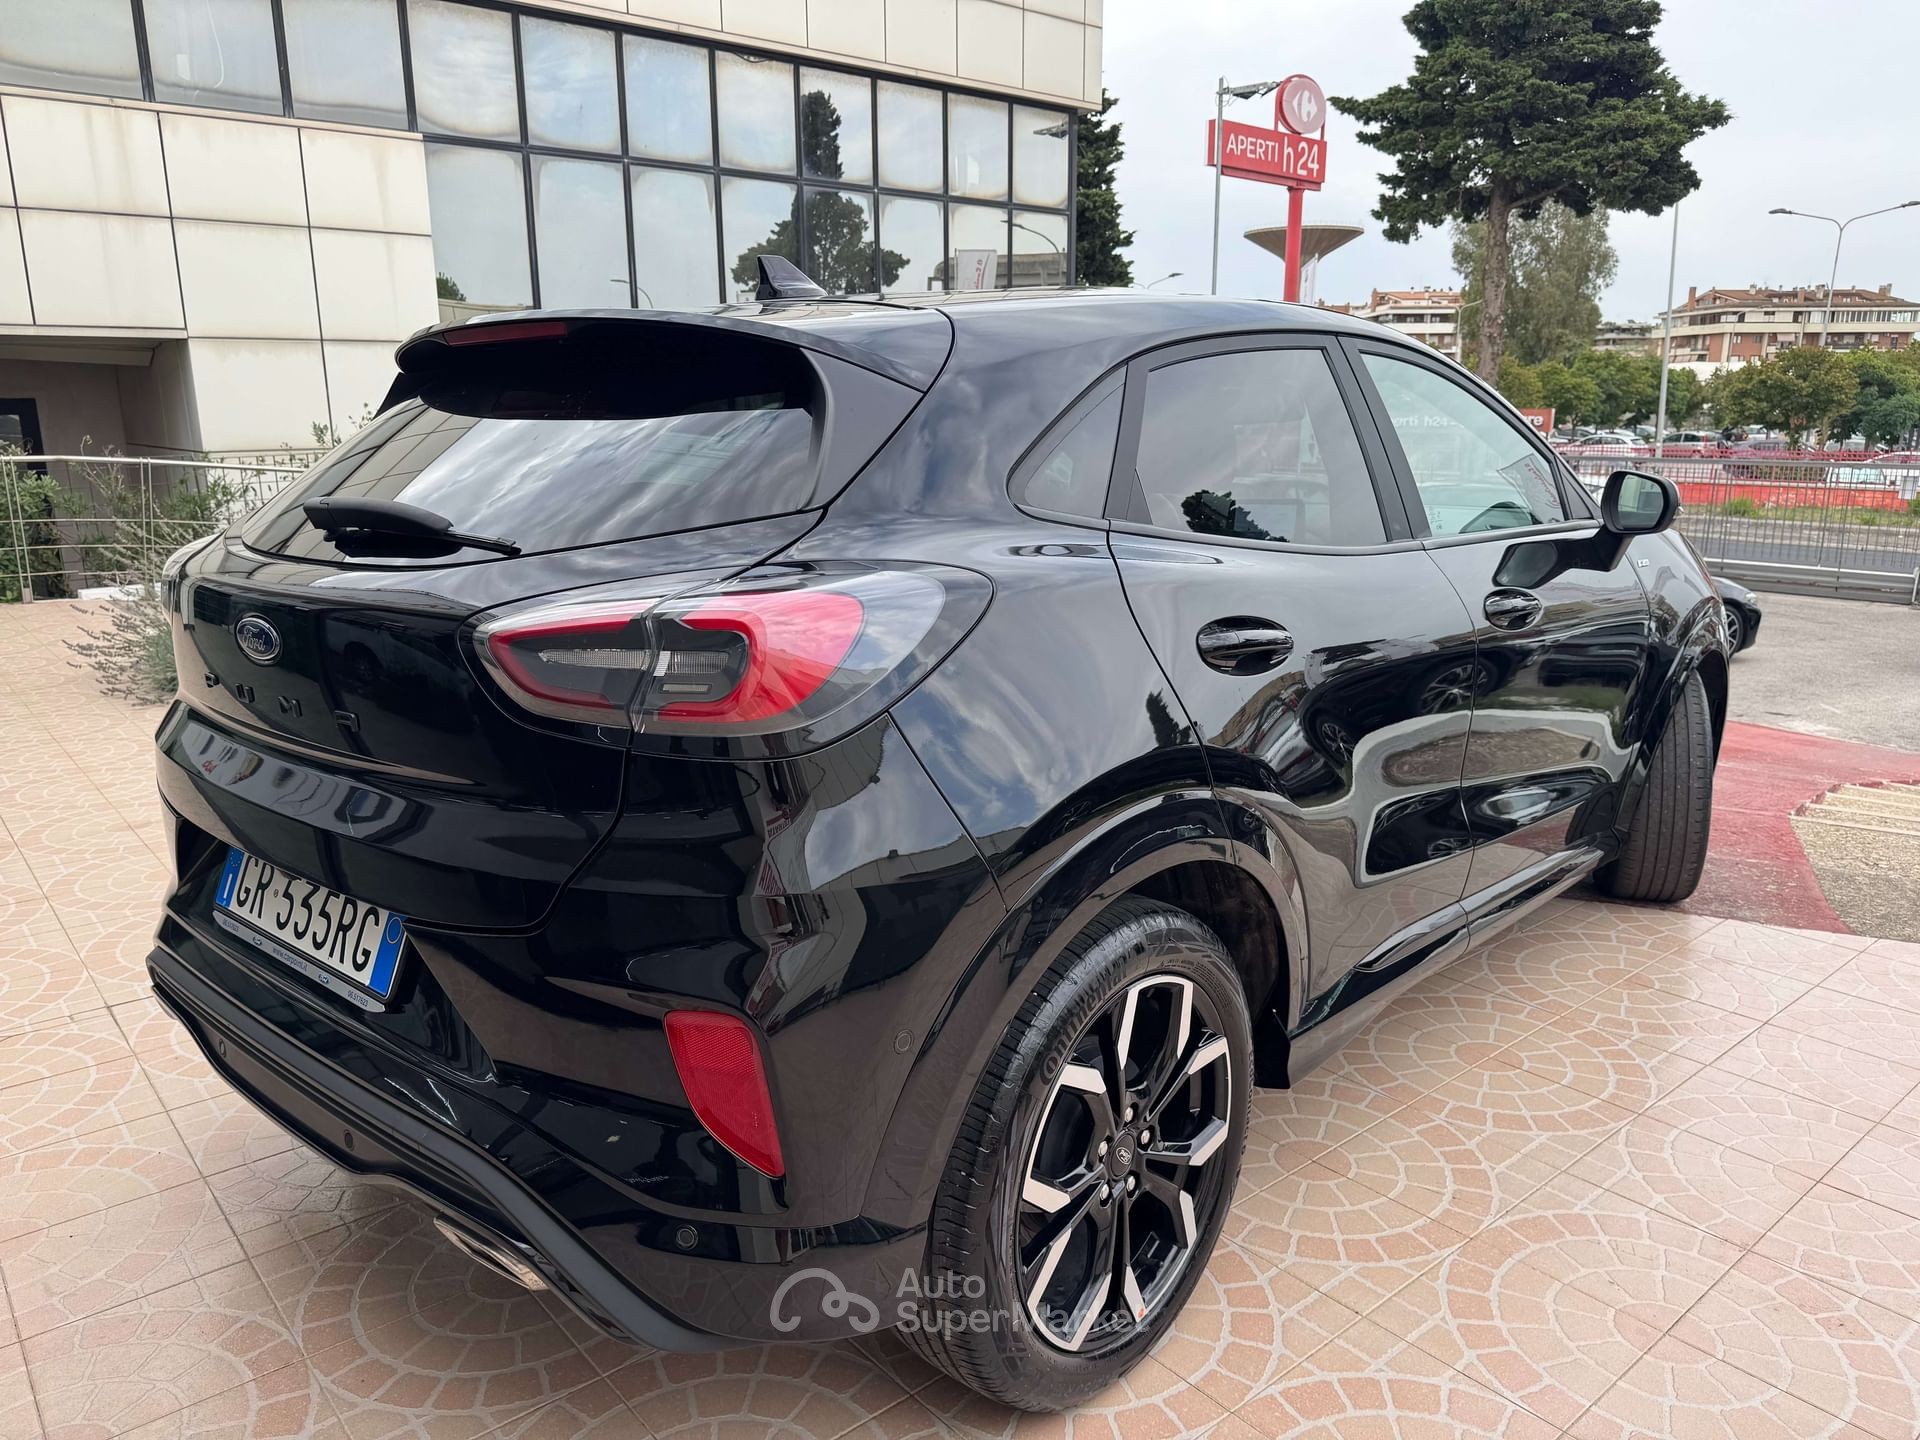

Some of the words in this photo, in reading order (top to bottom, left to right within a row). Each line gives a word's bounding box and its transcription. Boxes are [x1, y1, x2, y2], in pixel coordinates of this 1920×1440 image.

[1226, 133, 1279, 163] APERTI
[1282, 135, 1320, 178] h24
[240, 625, 266, 652] Ford
